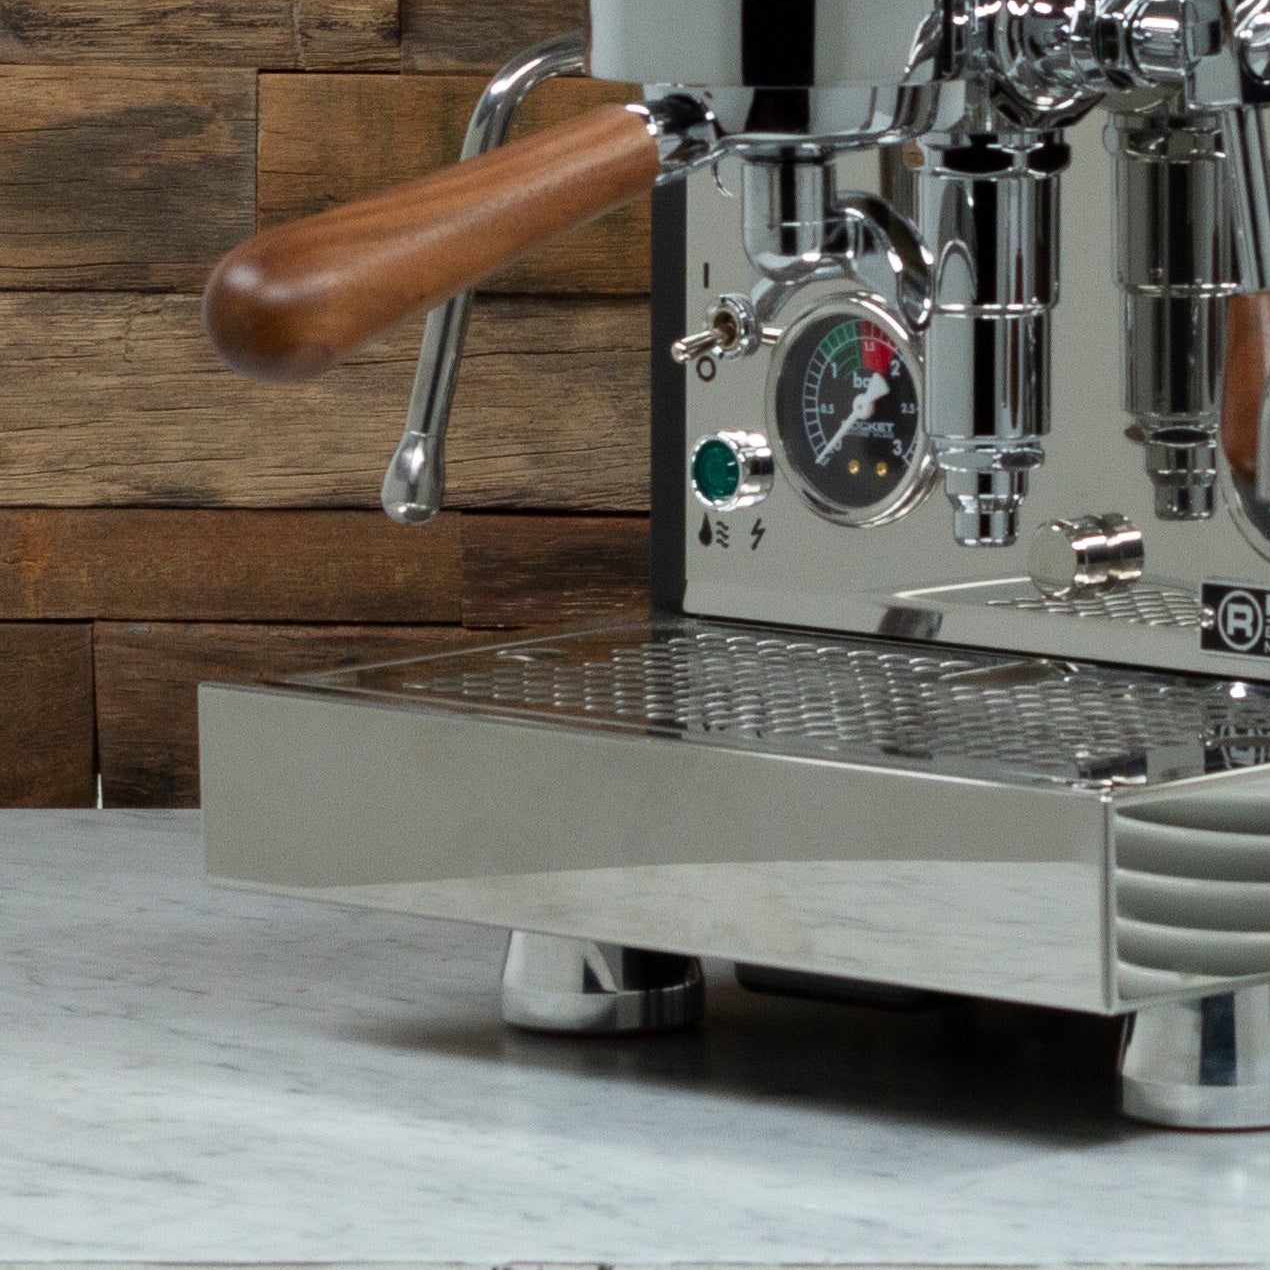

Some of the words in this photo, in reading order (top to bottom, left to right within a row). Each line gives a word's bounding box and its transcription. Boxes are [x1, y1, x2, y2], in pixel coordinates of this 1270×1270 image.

[831, 361, 838, 379] 1
[890, 360, 901, 377] 2
[820, 403, 835, 415] 0.5
[901, 402, 916, 415] 2.5
[892, 438, 903, 457] 3
[1226, 603, 1254, 637] R
